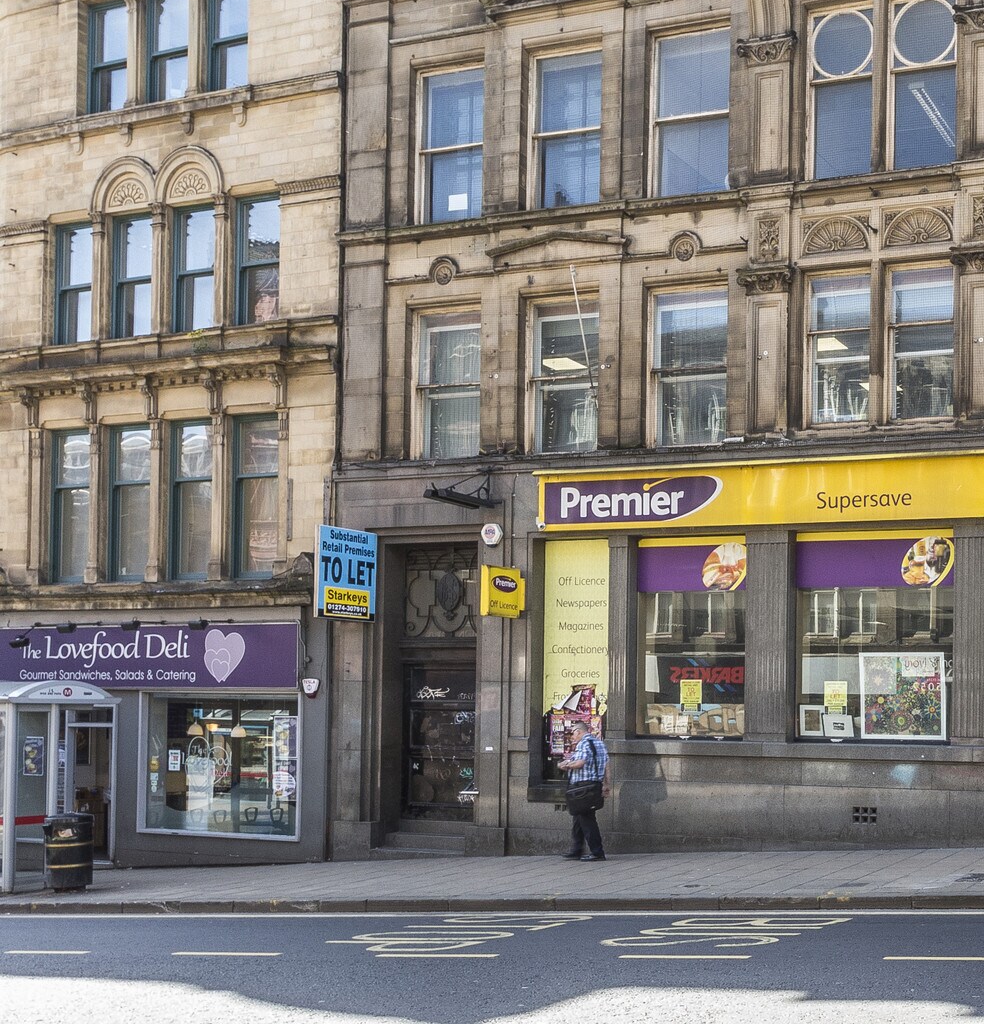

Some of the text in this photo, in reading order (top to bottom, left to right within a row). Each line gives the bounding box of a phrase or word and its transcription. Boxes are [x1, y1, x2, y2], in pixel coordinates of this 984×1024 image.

[560, 483, 685, 519] Premier
[816, 491, 912, 512] Supersave
[330, 529, 369, 545] Substantial
[322, 541, 375, 558] Retail Premises
[321, 556, 375, 587] TO LET
[495, 577, 517, 589] Premier
[558, 576, 606, 587] Off Licence
[327, 589, 368, 605] Starkeys
[556, 598, 608, 609] Newspapers
[490, 599, 518, 611] Off Licence
[558, 621, 604, 633] Magazines
[45, 631, 140, 668] Lovefood
[145, 630, 190, 659] Deli
[551, 644, 609, 656] Confectionery
[19, 669, 196, 683] Gourmet Sandwiches, Salads & Catering
[561, 668, 600, 679] Groceries
